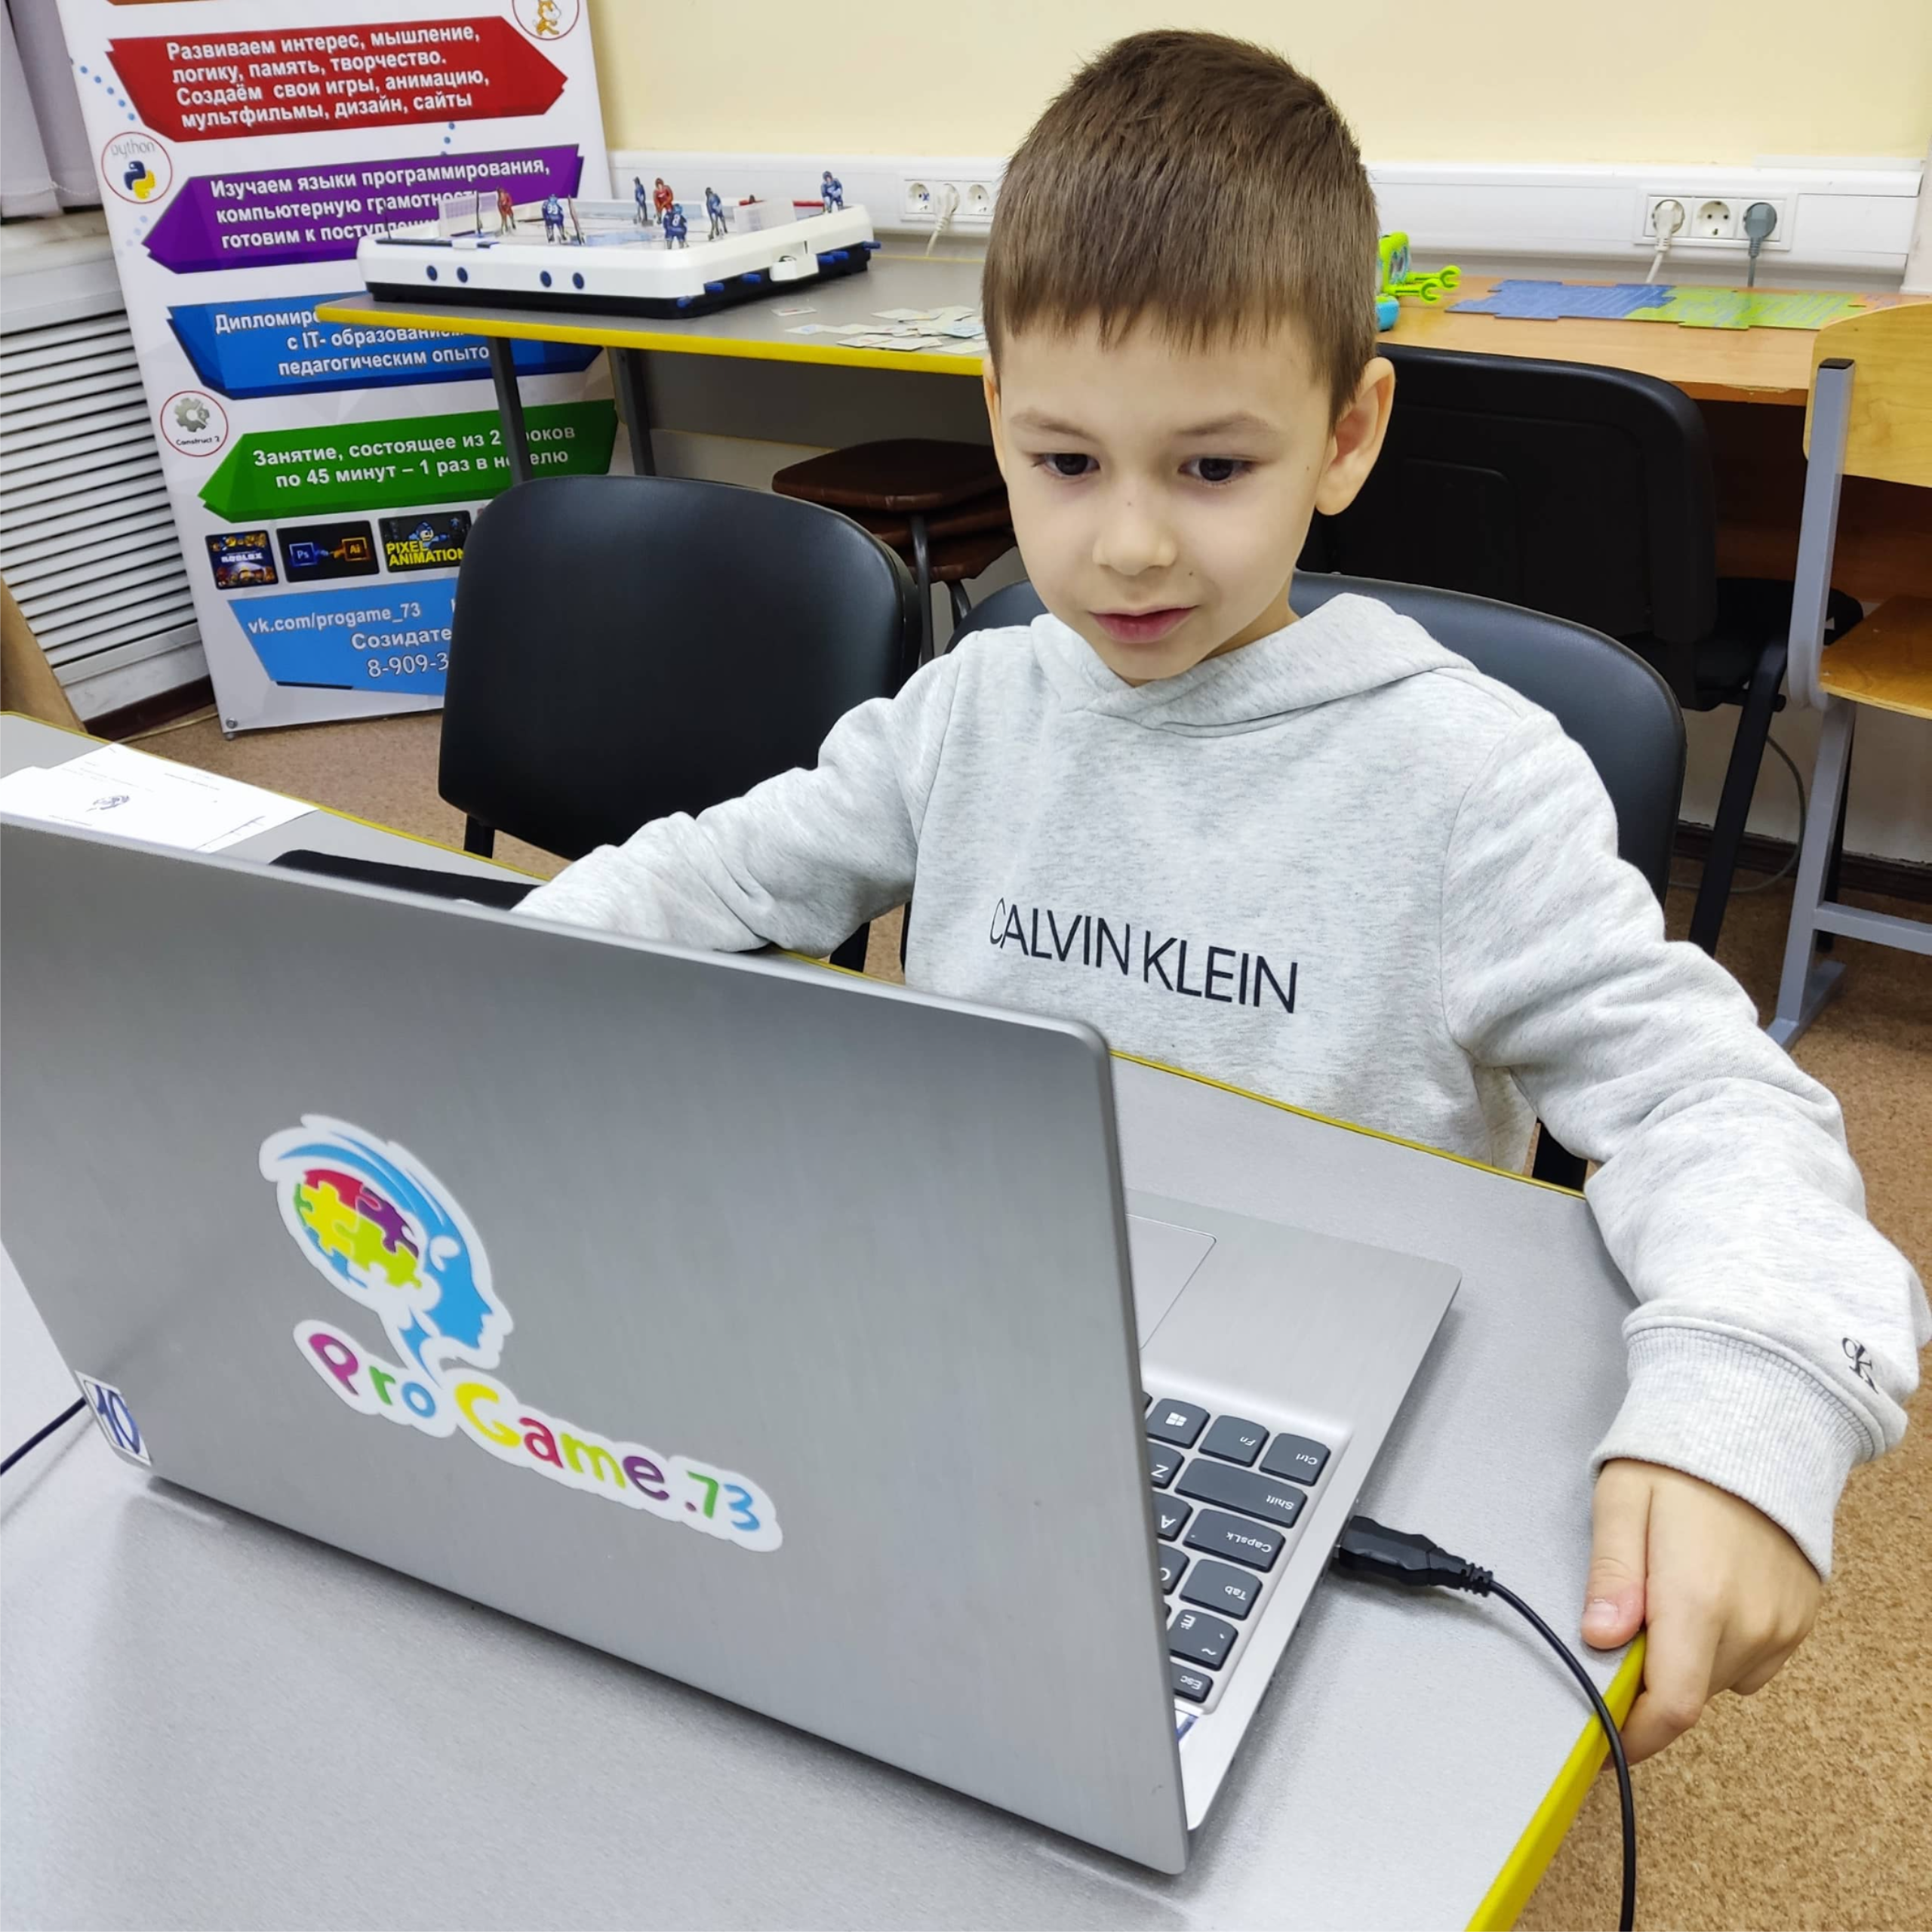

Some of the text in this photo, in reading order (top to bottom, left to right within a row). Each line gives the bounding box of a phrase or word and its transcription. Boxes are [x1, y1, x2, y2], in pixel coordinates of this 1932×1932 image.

[167, 26, 480, 60] Развиваем интерес, мышление,
[173, 51, 446, 84] логику, память, творчество.
[177, 69, 489, 106] Создаём свои игры, анимацию,
[181, 91, 472, 131] мультфильмы, дизайн, сайты
[211, 159, 550, 200] Изучаем языки программирования,
[217, 198, 361, 223] компьютерную
[221, 229, 300, 248] готовим
[305, 228, 316, 242] к
[287, 337, 298, 350] с
[278, 346, 489, 376] педагогическим опыто
[253, 447, 343, 466] Занятие,
[349, 437, 456, 457] состоящее
[462, 435, 485, 448] из
[490, 429, 502, 445] 2
[276, 474, 300, 488] по
[306, 468, 330, 484] 45
[336, 466, 396, 483] минут
[420, 459, 429, 475] 1
[436, 459, 469, 477] раз
[476, 457, 488, 469] в
[386, 540, 429, 555] PIXEL
[248, 602, 421, 633] vk.com/progame_73
[352, 628, 452, 649] Созидате
[368, 652, 449, 677] 8-909-3
[990, 897, 1298, 1014] CALVIN KLEIN
[1240, 1436, 1256, 1446] Fn
[1151, 1464, 1169, 1478] Z
[1296, 1453, 1318, 1466] Ctrl
[1266, 1495, 1294, 1510] Shift
[1161, 1515, 1176, 1528] A
[1226, 1531, 1272, 1552] CapsLk
[1225, 1586, 1247, 1600] Tab
[1180, 1675, 1203, 1690] Esc
